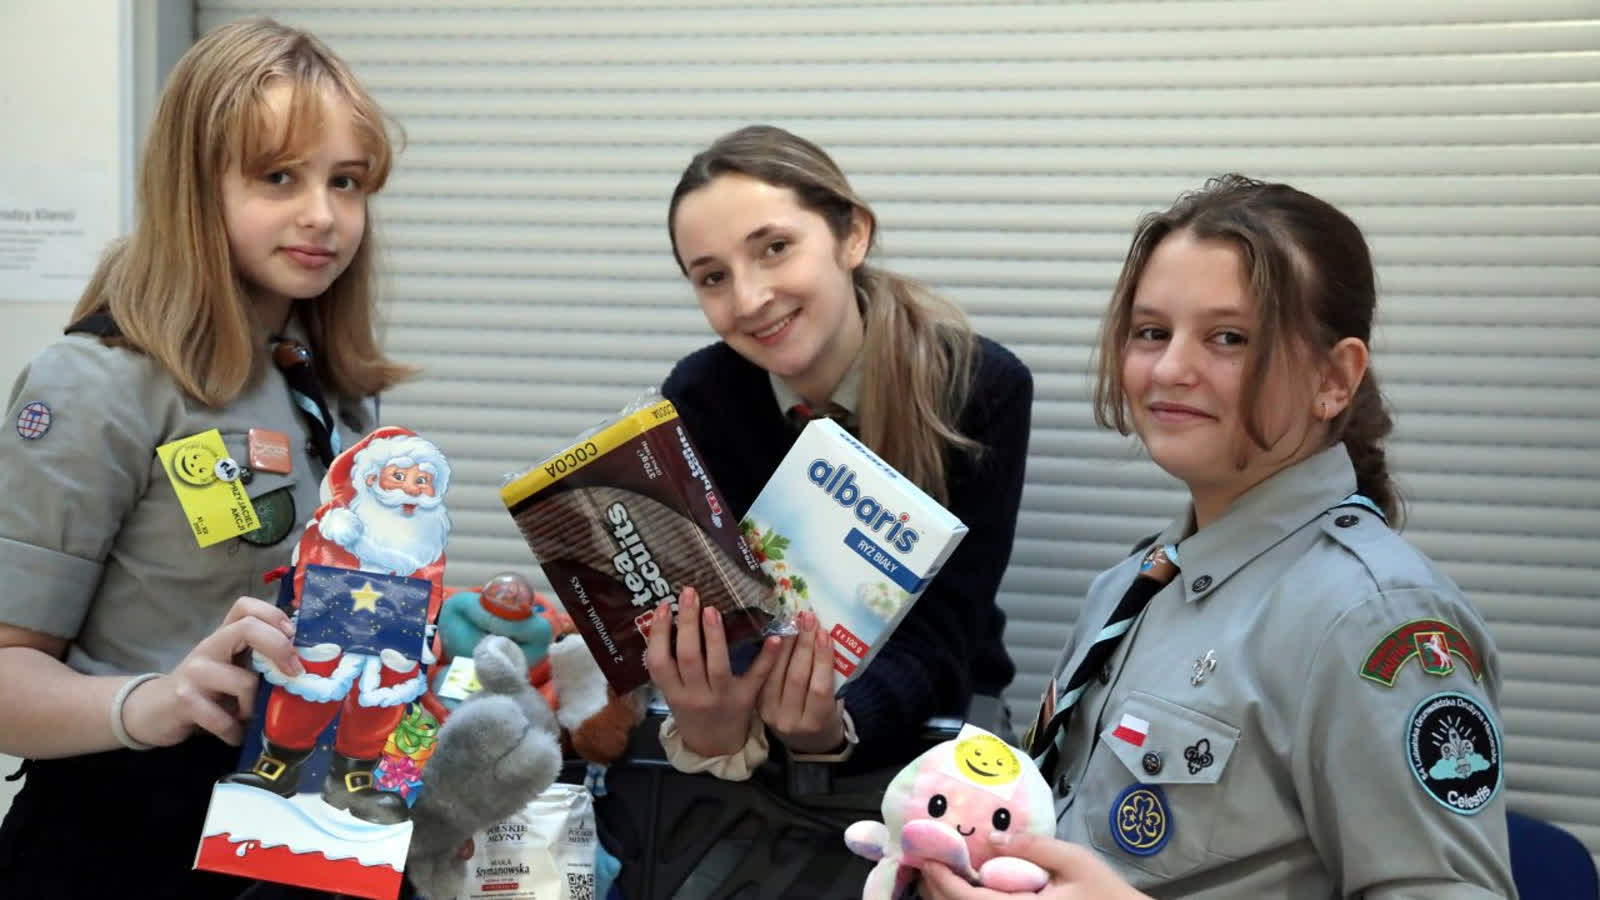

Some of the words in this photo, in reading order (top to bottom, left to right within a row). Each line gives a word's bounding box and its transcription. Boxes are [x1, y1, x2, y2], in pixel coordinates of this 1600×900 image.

[544, 441, 598, 478] COCOA
[676, 425, 712, 490] biscuits
[682, 449, 699, 478] tea
[839, 432, 898, 479] albaris
[231, 507, 247, 531] AKCJI
[808, 458, 919, 554] albaris
[607, 502, 680, 622] iscuits
[857, 539, 877, 557] RYŻ
[872, 552, 899, 573] BIAŁY
[569, 576, 590, 605] PACKS
[613, 551, 653, 606] tea
[587, 605, 618, 655] INDIVIDUAL
[845, 637, 858, 650] 100
[614, 655, 623, 664] 2
[1447, 785, 1491, 809] Celestis
